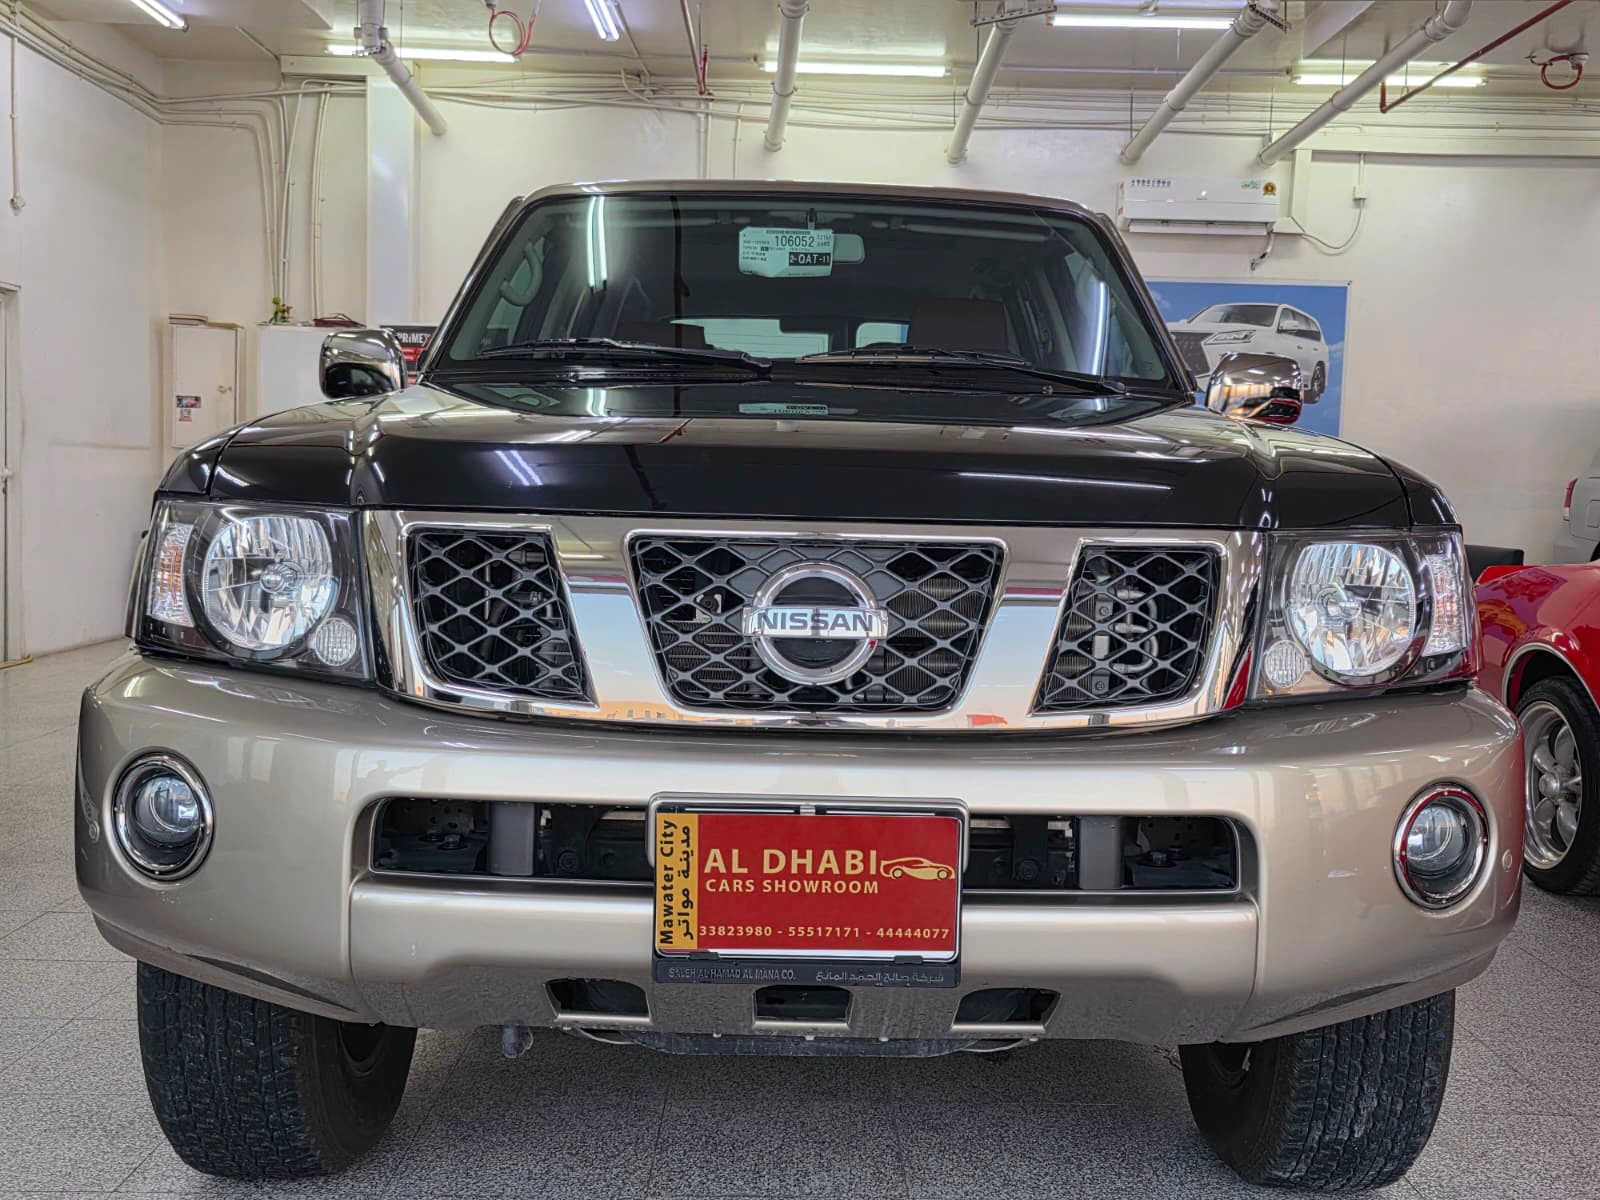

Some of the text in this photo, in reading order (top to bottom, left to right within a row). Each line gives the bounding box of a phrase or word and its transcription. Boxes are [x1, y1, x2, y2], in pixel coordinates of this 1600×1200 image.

[775, 234, 815, 248] 106052
[757, 611, 873, 632] NISSAN
[703, 848, 877, 875] AL DHABI
[660, 820, 677, 944] Mawater City
[677, 825, 694, 940] مدينة مواتر
[705, 879, 879, 894] CARS SHOWROOM
[699, 925, 772, 936] 33823980
[788, 926, 860, 937] 55517171
[876, 927, 950, 938] 44444077
[668, 967, 796, 980] SALEH AL HAMAD AL MANA CO.
